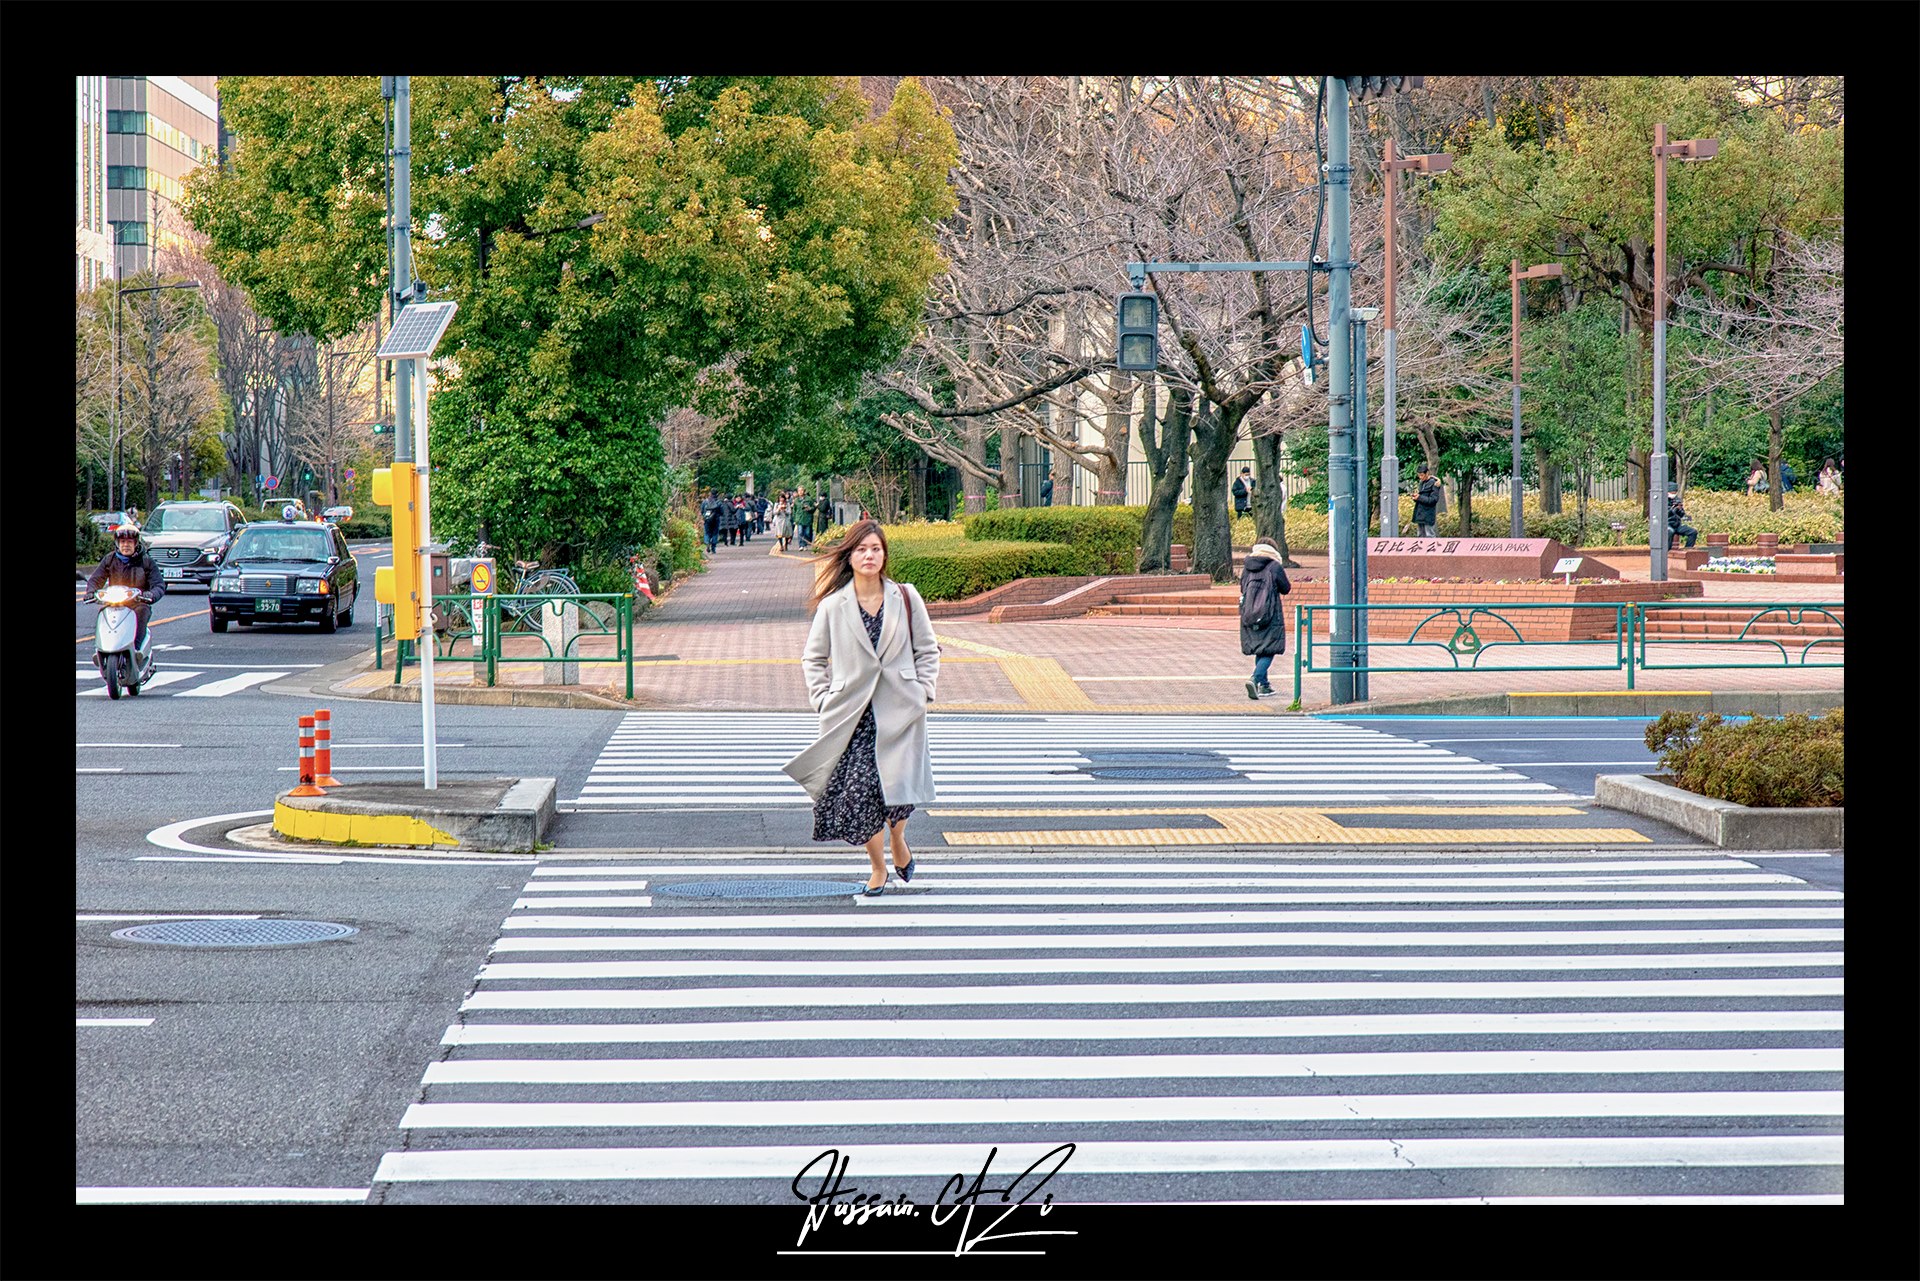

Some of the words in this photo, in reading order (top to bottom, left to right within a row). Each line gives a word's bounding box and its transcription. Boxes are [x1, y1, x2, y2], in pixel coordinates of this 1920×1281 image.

[1373, 540, 1461, 554] 日比谷公園
[1469, 543, 1503, 552] HIBIYA
[1504, 543, 1533, 552] PARK
